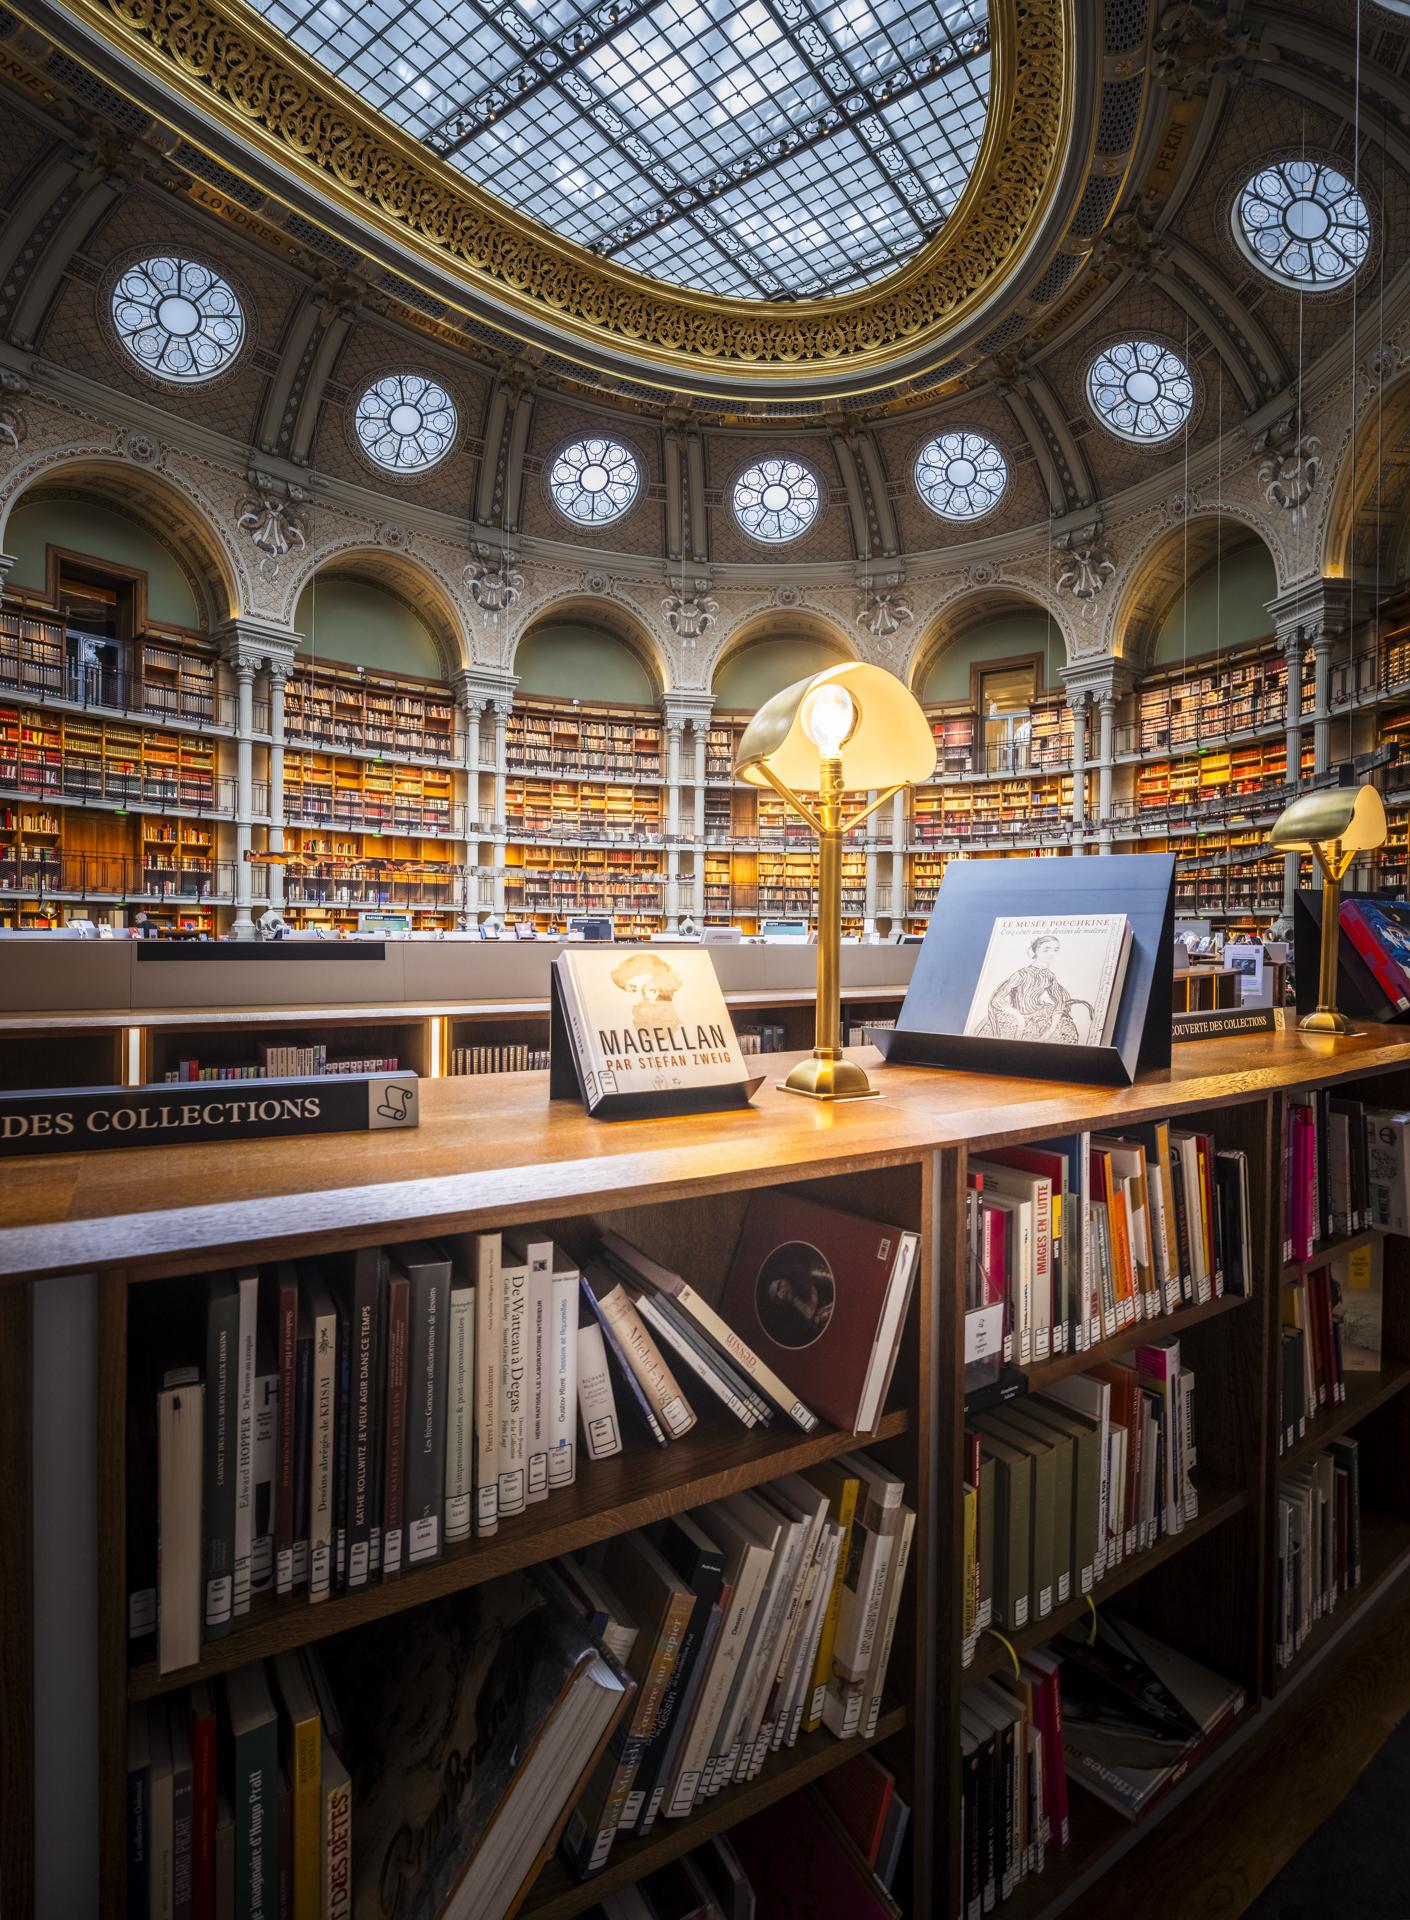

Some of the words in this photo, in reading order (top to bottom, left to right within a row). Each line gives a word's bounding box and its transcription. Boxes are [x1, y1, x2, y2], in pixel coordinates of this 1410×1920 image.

[1156, 121, 1185, 172] PEKIN
[199, 191, 282, 246] LONDRES
[1042, 280, 1097, 336] CARTHAGE
[401, 308, 469, 345] BABYLONE
[576, 382, 622, 403] VIENNE
[904, 387, 944, 406] ROME
[1016, 920, 1046, 928] MUSÉE
[1050, 918, 1110, 928] POUCHKINE
[1209, 1020, 1224, 1031] DES
[1223, 1016, 1268, 1030] COLLECTIONS
[598, 1024, 727, 1056] MAGELLAN
[606, 1059, 632, 1072] PAR
[638, 1055, 688, 1070] STEFAN
[692, 1052, 732, 1066] ZWEIG
[1, 1112, 74, 1138] DES
[86, 1096, 321, 1132] COLLECTIONS
[1036, 1184, 1048, 1216] LUTTE
[1036, 1220, 1048, 1232] EN
[1036, 1236, 1047, 1275] IMAGES
[427, 1287, 436, 1314] dessins
[511, 1276, 524, 1296] De
[360, 1306, 371, 1336] TEMPS
[426, 1314, 436, 1324] de
[510, 1297, 524, 1354] Watteau
[218, 1330, 228, 1362] DESSINS
[284, 1351, 293, 1369] Hand
[360, 1338, 370, 1350] CE
[511, 1356, 524, 1364] à
[559, 1346, 567, 1374] Dessins
[359, 1352, 370, 1378] DANS
[626, 1327, 672, 1406] Michel-Ang
[320, 1377, 330, 1418] KEISAI
[358, 1380, 368, 1403] AGIR
[424, 1380, 434, 1416] Goncourt
[485, 1364, 495, 1410] dessinateur
[506, 1366, 524, 1413] Degas
[558, 1378, 567, 1395] Klimt
[358, 1403, 368, 1432] VEUX
[456, 1406, 464, 1414] &
[558, 1396, 567, 1422] Gustav
[240, 1416, 251, 1466] HOPPER
[319, 1420, 330, 1432] de
[358, 1432, 366, 1442] JE
[484, 1428, 495, 1452] Pierre
[318, 1434, 330, 1472] abrégés
[423, 1440, 432, 1454] Les
[356, 1446, 366, 1492] KOLLWITZ
[238, 1469, 250, 1509] Edward
[317, 1474, 330, 1512] Dessins
[655, 1664, 667, 1685] sur
[664, 1618, 682, 1662] papier
[659, 1688, 678, 1731] dessin
[616, 1742, 642, 1794] Munch
[249, 1770, 262, 1800] Pratt
[174, 1816, 192, 1854] PICART
[249, 1804, 264, 1847] d'Hugo
[174, 1855, 192, 1904] BERNARD
[248, 1850, 264, 1911] imaginaire
